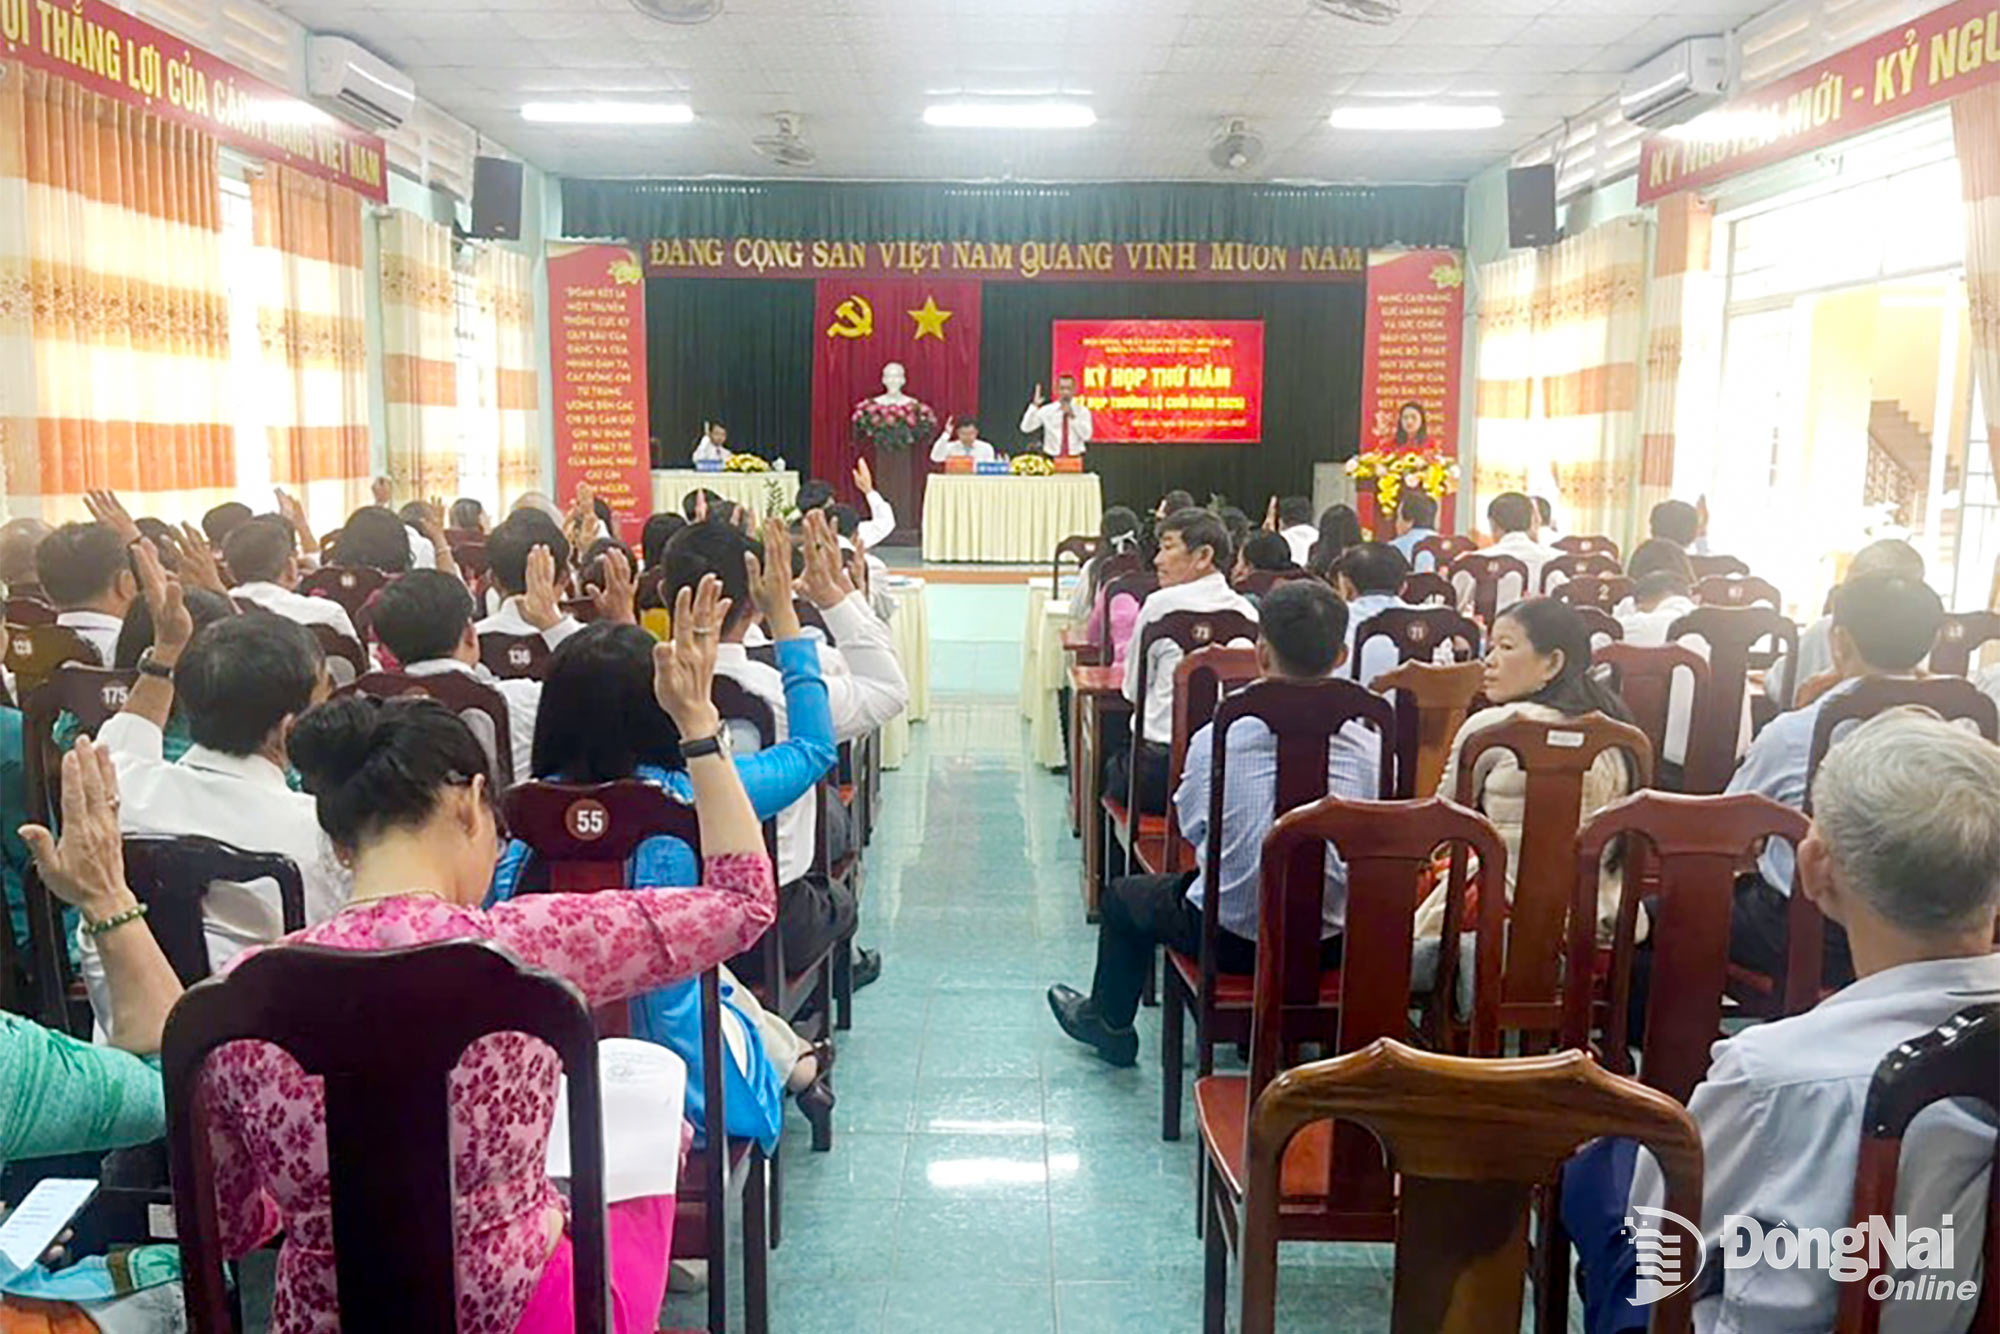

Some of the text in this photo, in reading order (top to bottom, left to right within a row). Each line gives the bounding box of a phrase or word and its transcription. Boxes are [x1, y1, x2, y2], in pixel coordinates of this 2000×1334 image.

[36, 0, 122, 82] THẮNG
[127, 39, 162, 104] LỢI
[168, 49, 209, 117] CỦA
[1786, 71, 1844, 136] MỚI
[1873, 29, 1920, 106] KỶ
[952, 241, 1014, 269] NAM
[1020, 240, 1113, 277] QUANG
[1124, 241, 1197, 271] VINH
[1151, 364, 1188, 388] THỨ
[1189, 363, 1232, 388] NĂM
[1598, 583, 1610, 601] 2
[102, 685, 128, 704] 175
[576, 810, 603, 832] 55
